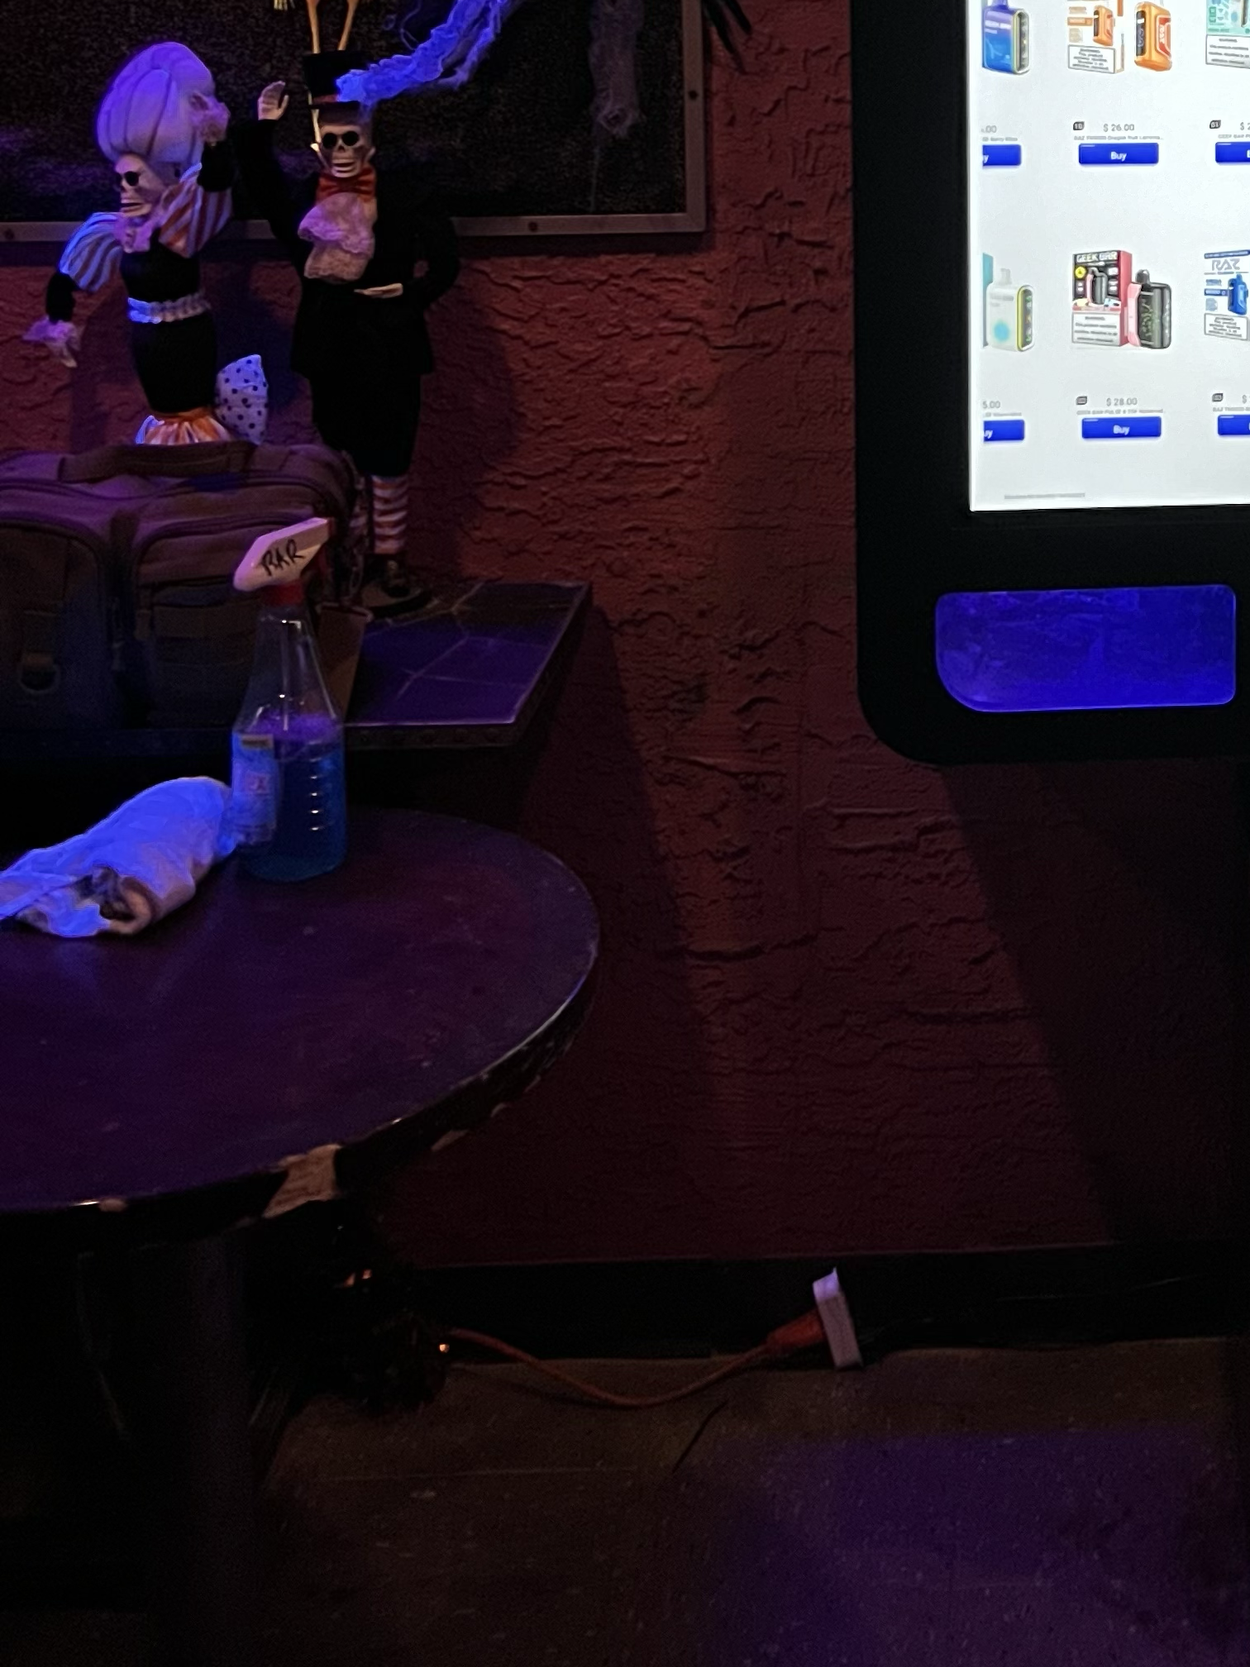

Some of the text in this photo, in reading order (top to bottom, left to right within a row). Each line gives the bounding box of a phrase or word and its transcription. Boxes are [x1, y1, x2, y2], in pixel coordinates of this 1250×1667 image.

[1111, 123, 1135, 132] 26.00
[1110, 151, 1127, 162] Buy
[1212, 258, 1241, 271] RAZ
[1113, 397, 1138, 406] 28.00
[1113, 424, 1130, 435] Buy
[260, 537, 306, 578] BAR
